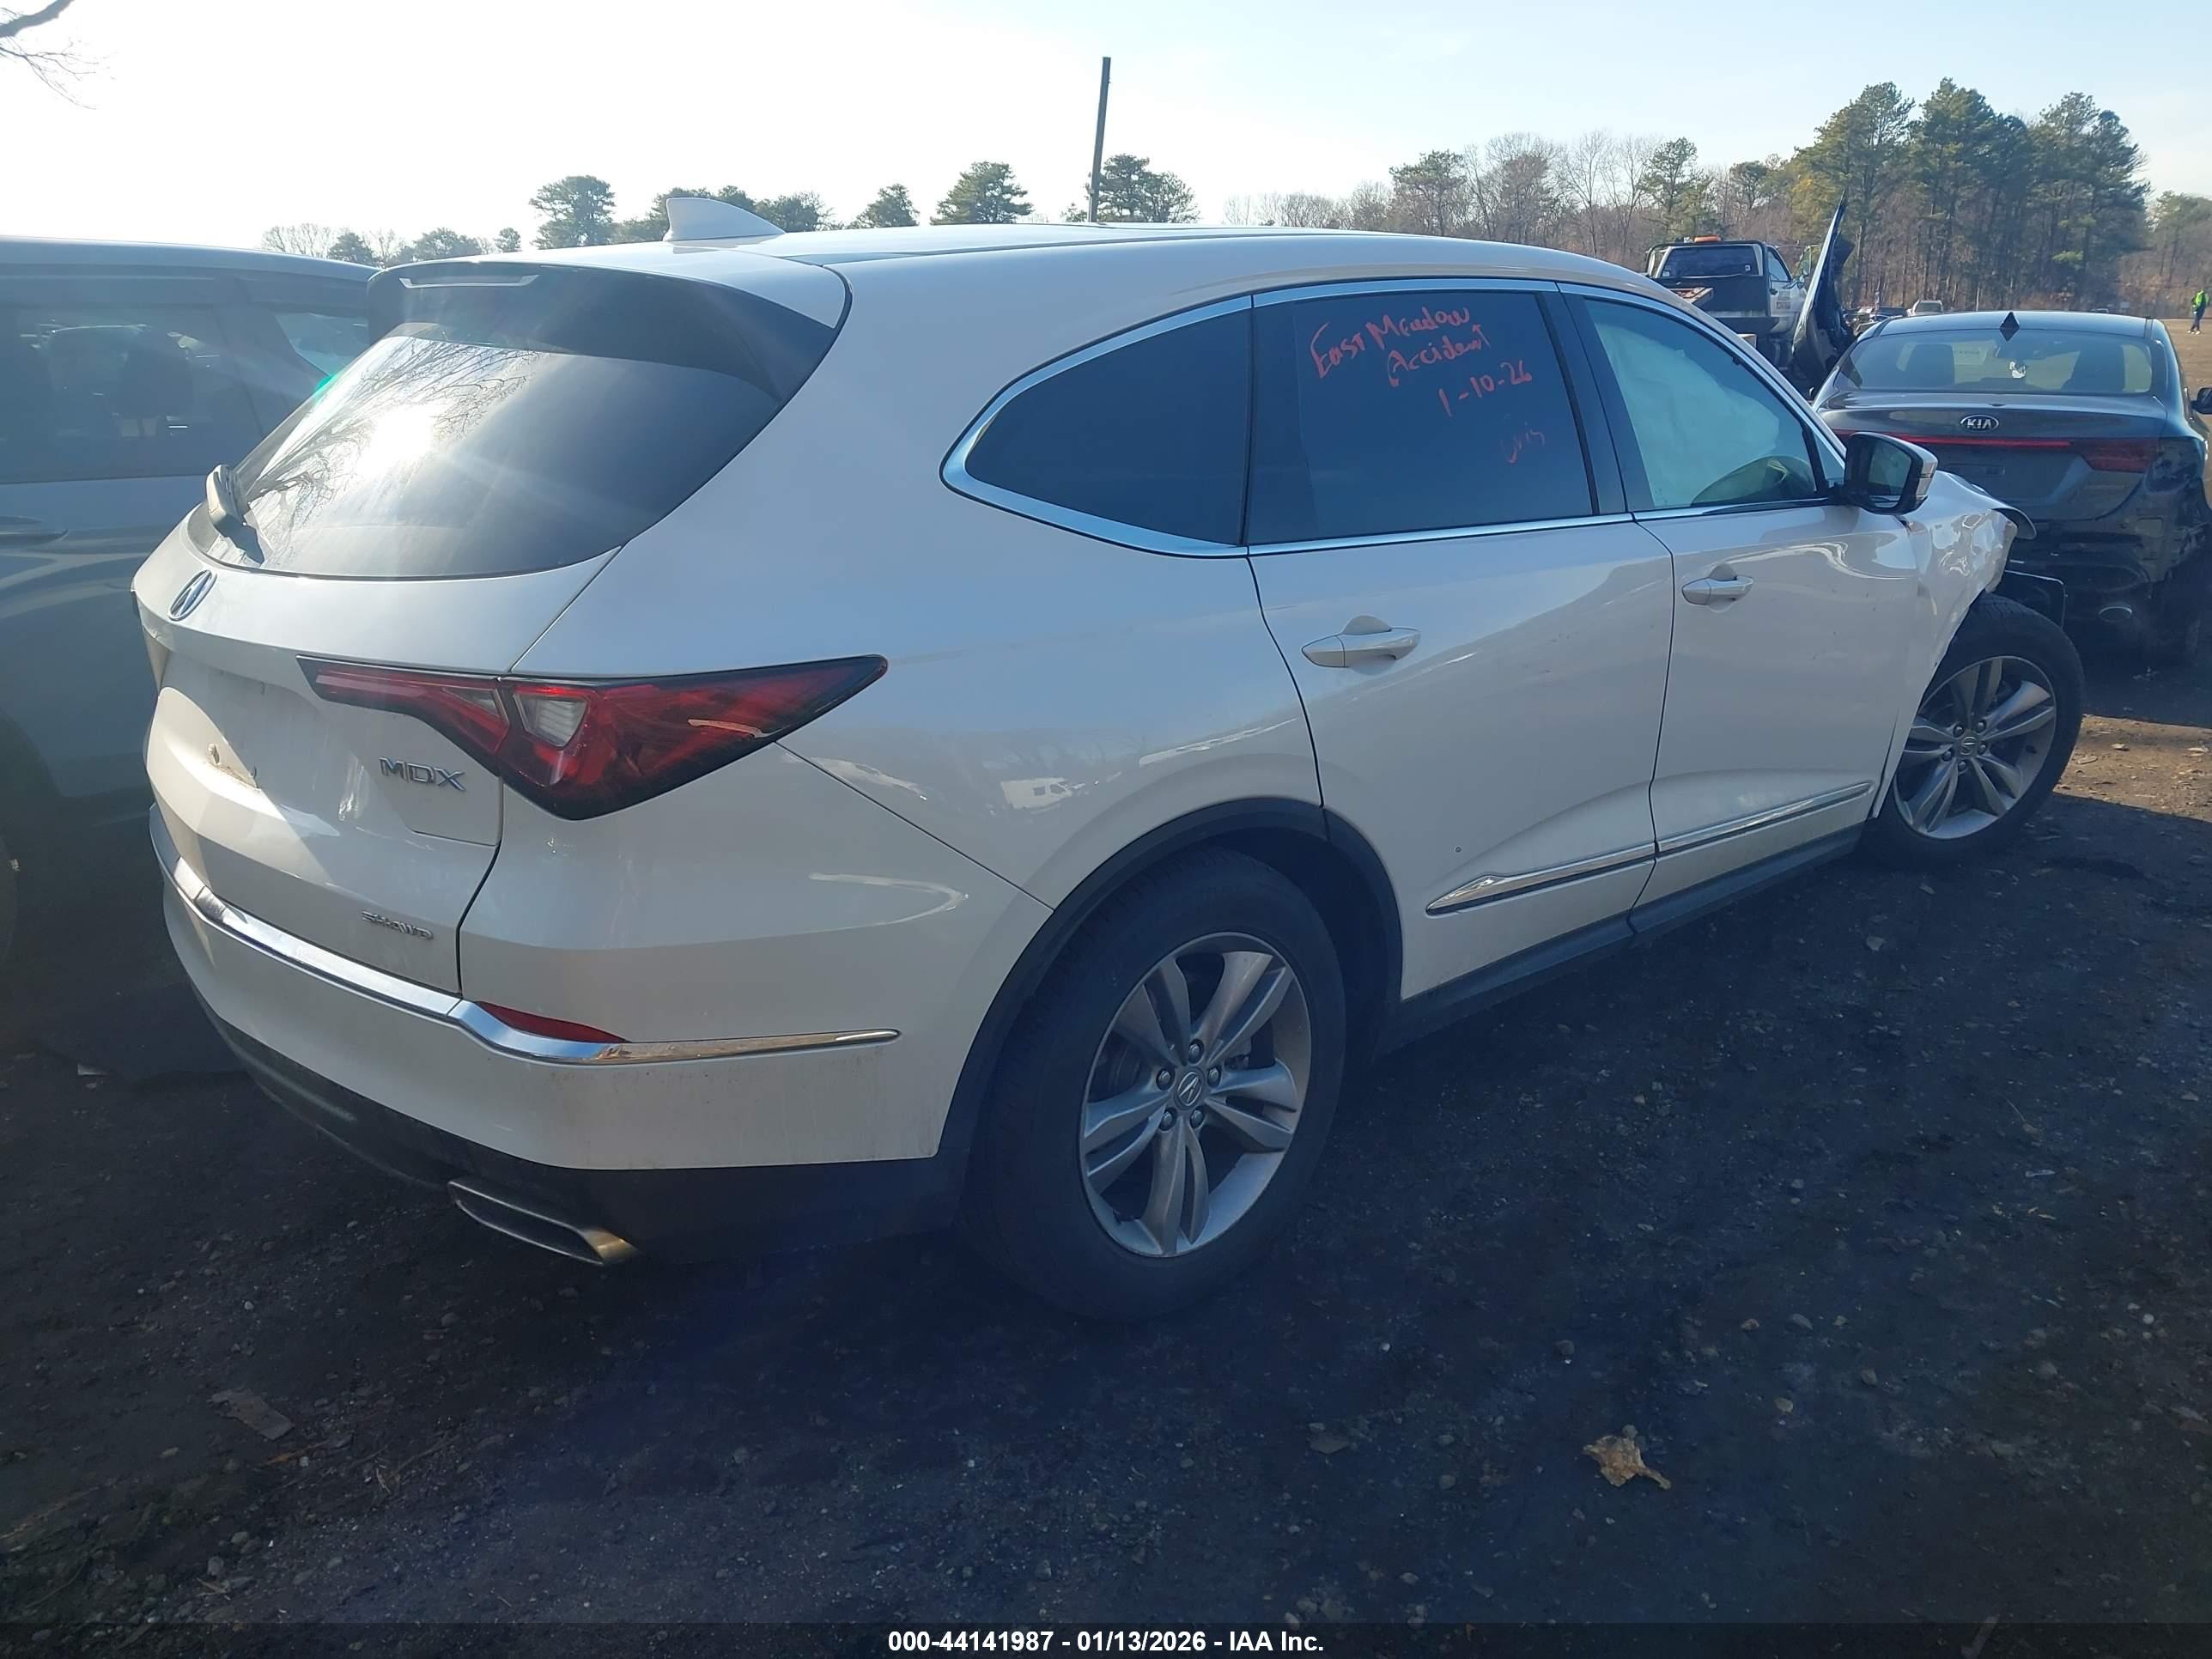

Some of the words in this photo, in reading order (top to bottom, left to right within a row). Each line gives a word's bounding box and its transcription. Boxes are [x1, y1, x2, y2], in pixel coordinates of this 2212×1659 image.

[1437, 360, 1533, 417] 1-10-26
[1966, 418, 1992, 429] KIA
[378, 756, 465, 792] MDX
